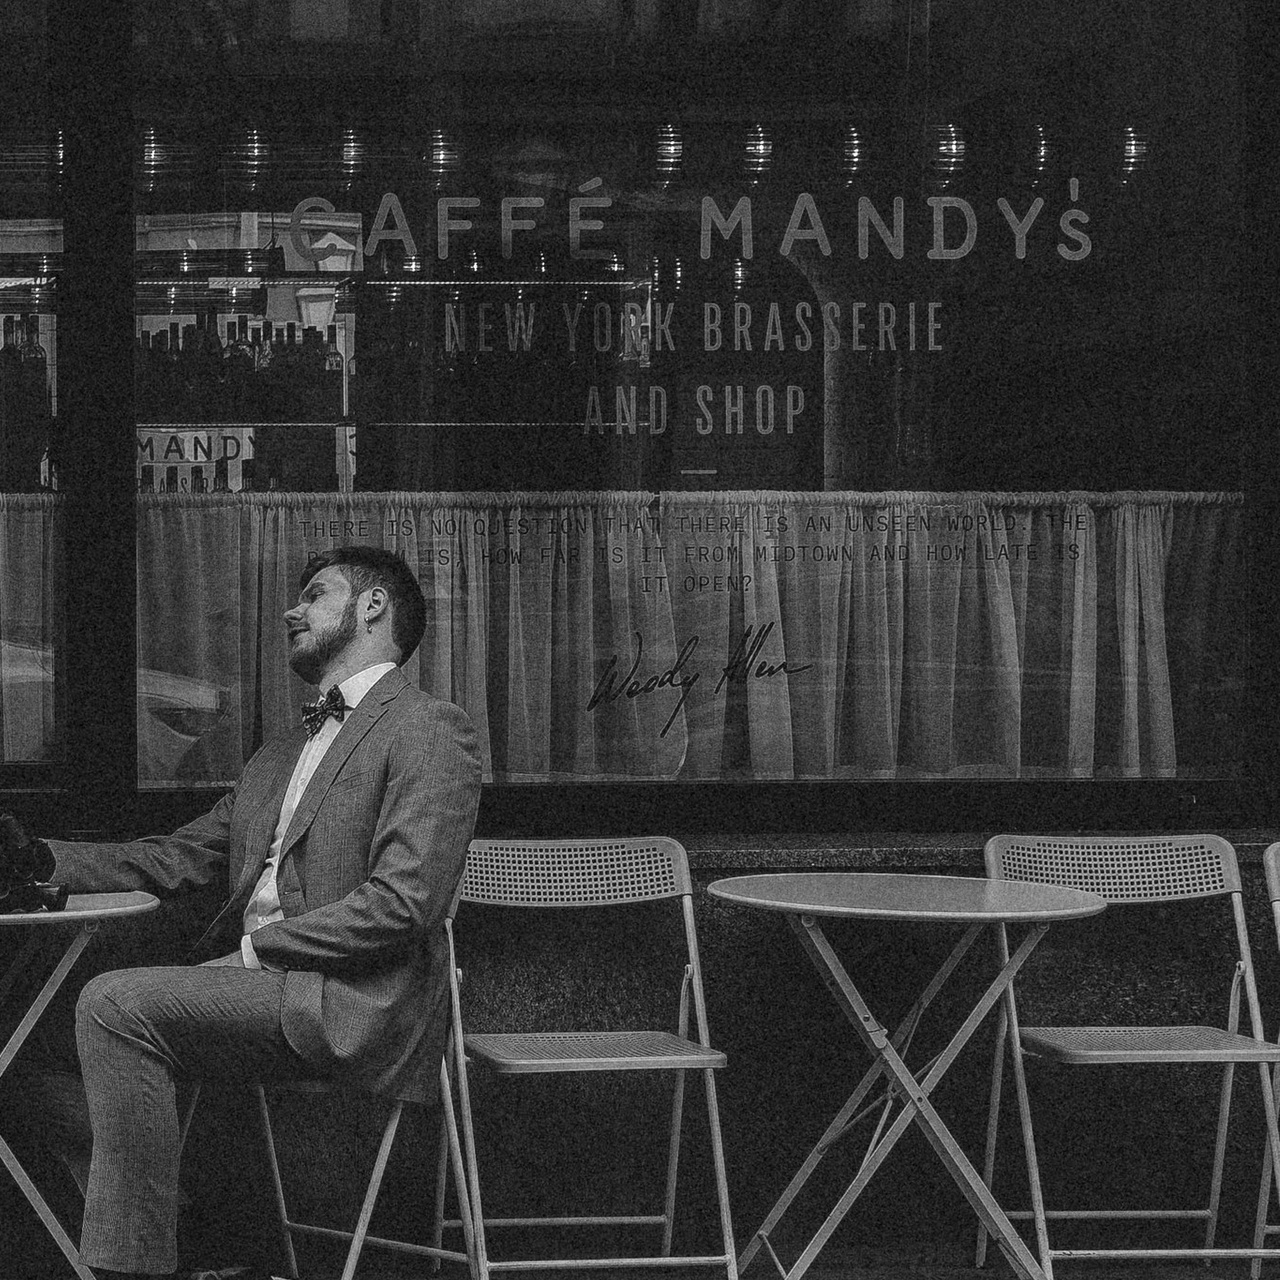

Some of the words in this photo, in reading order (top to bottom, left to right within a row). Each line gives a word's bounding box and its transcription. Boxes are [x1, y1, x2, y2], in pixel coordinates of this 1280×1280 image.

[291, 176, 618, 262] CAFFÉ
[445, 302, 537, 353] NEW
[563, 301, 677, 353] YORK
[704, 301, 943, 352] BRASSERIE
[583, 385, 668, 435] AND
[696, 384, 806, 435] SHOP
[137, 434, 255, 461] MAND
[298, 519, 370, 538] THERE
[386, 519, 414, 537] IS
[431, 518, 458, 536] NO
[473, 517, 588, 537] QUESTION
[605, 516, 661, 535] THAT
[674, 516, 746, 534] THERE
[763, 515, 789, 534] IS
[805, 515, 832, 533] AN
[847, 515, 932, 532] UNSEEN
[946, 514, 1028, 532] WORLD.
[1045, 513, 1089, 531] THE
[481, 548, 523, 566] HOW
[539, 547, 581, 565] FAR
[598, 547, 625, 564] IS
[641, 546, 667, 563] IT
[684, 546, 740, 563] FROM
[755, 545, 853, 563] MIDTOWN
[869, 544, 911, 562] AND
[926, 544, 967, 561] HOW
[984, 543, 1039, 561] LATE
[1052, 542, 1081, 561] IS
[641, 576, 668, 594] IT
[683, 574, 753, 593] OPEN?
